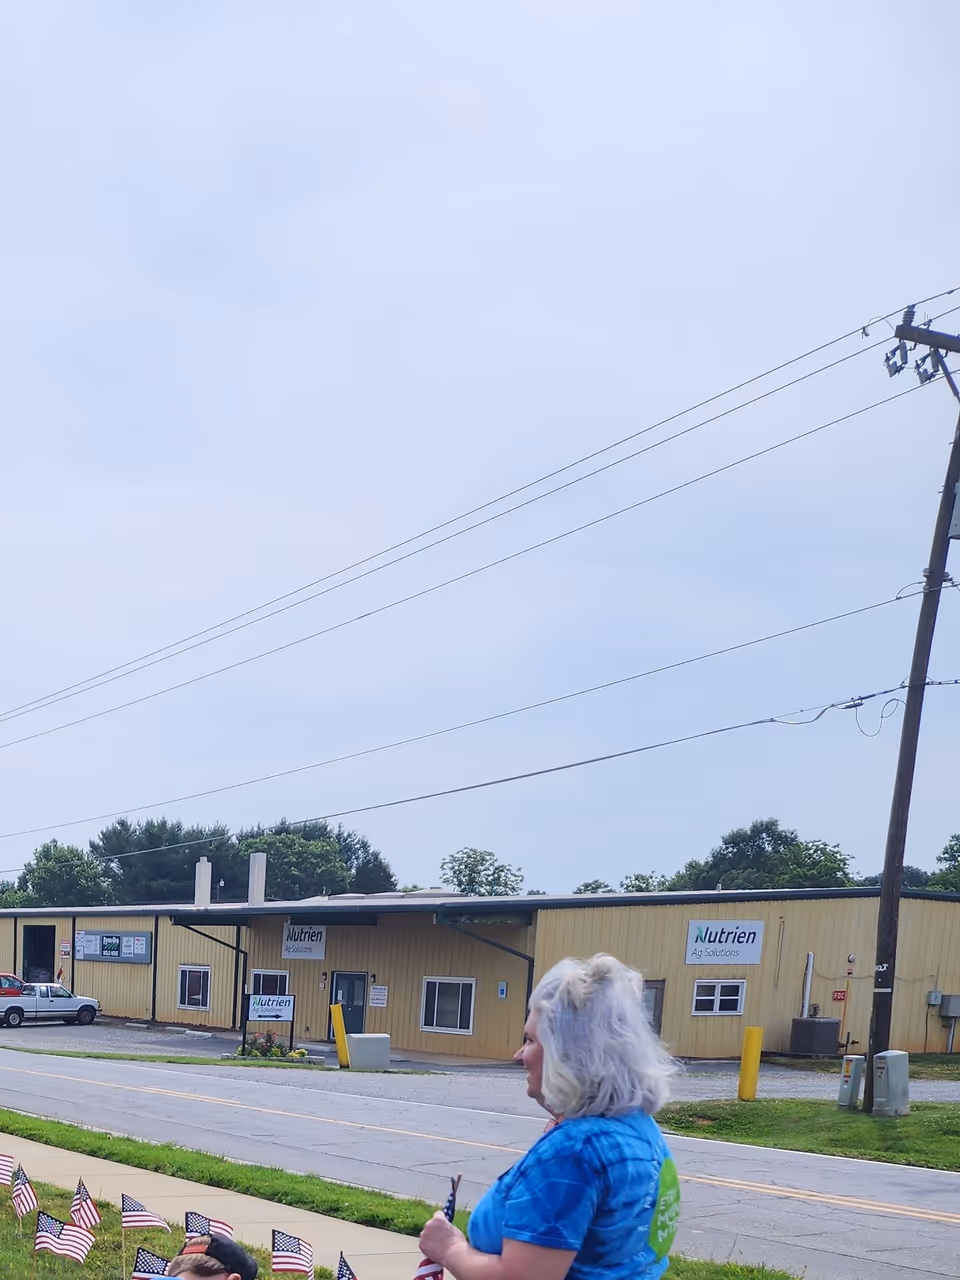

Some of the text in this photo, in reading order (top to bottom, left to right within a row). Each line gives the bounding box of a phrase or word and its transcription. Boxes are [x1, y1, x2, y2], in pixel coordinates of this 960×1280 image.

[286, 926, 323, 942] Nutrien
[695, 926, 757, 944] Nutrien
[691, 947, 739, 959] Ag Solutions
[253, 996, 291, 1007] Nutrien
